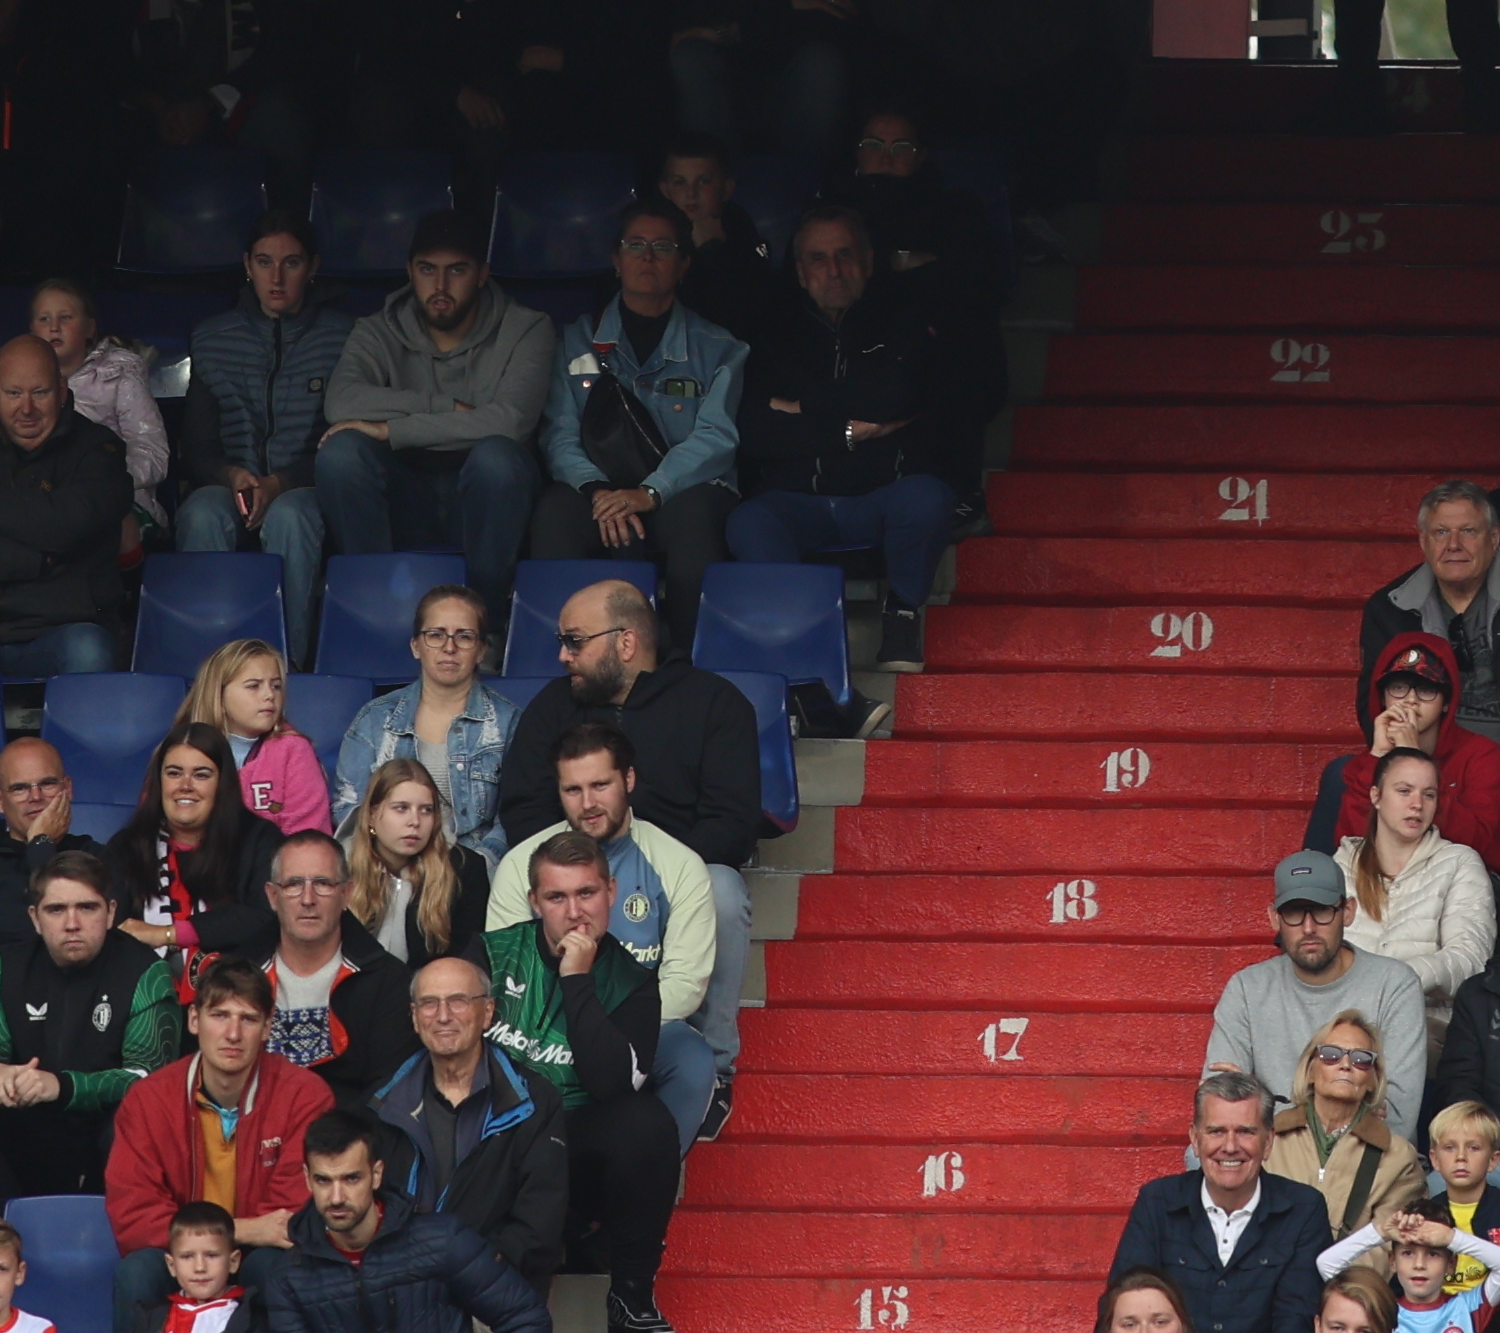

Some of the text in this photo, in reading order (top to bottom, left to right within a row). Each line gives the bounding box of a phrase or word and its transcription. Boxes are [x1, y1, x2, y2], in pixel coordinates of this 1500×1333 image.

[1269, 338, 1331, 382] 22
[1217, 476, 1271, 526] 21
[1150, 611, 1214, 658] 20
[1100, 747, 1151, 793] 19
[251, 782, 271, 810] E
[1046, 879, 1099, 924] 18
[978, 1017, 1030, 1063] 17
[917, 1151, 967, 1197] 16
[854, 1285, 909, 1332] 15
